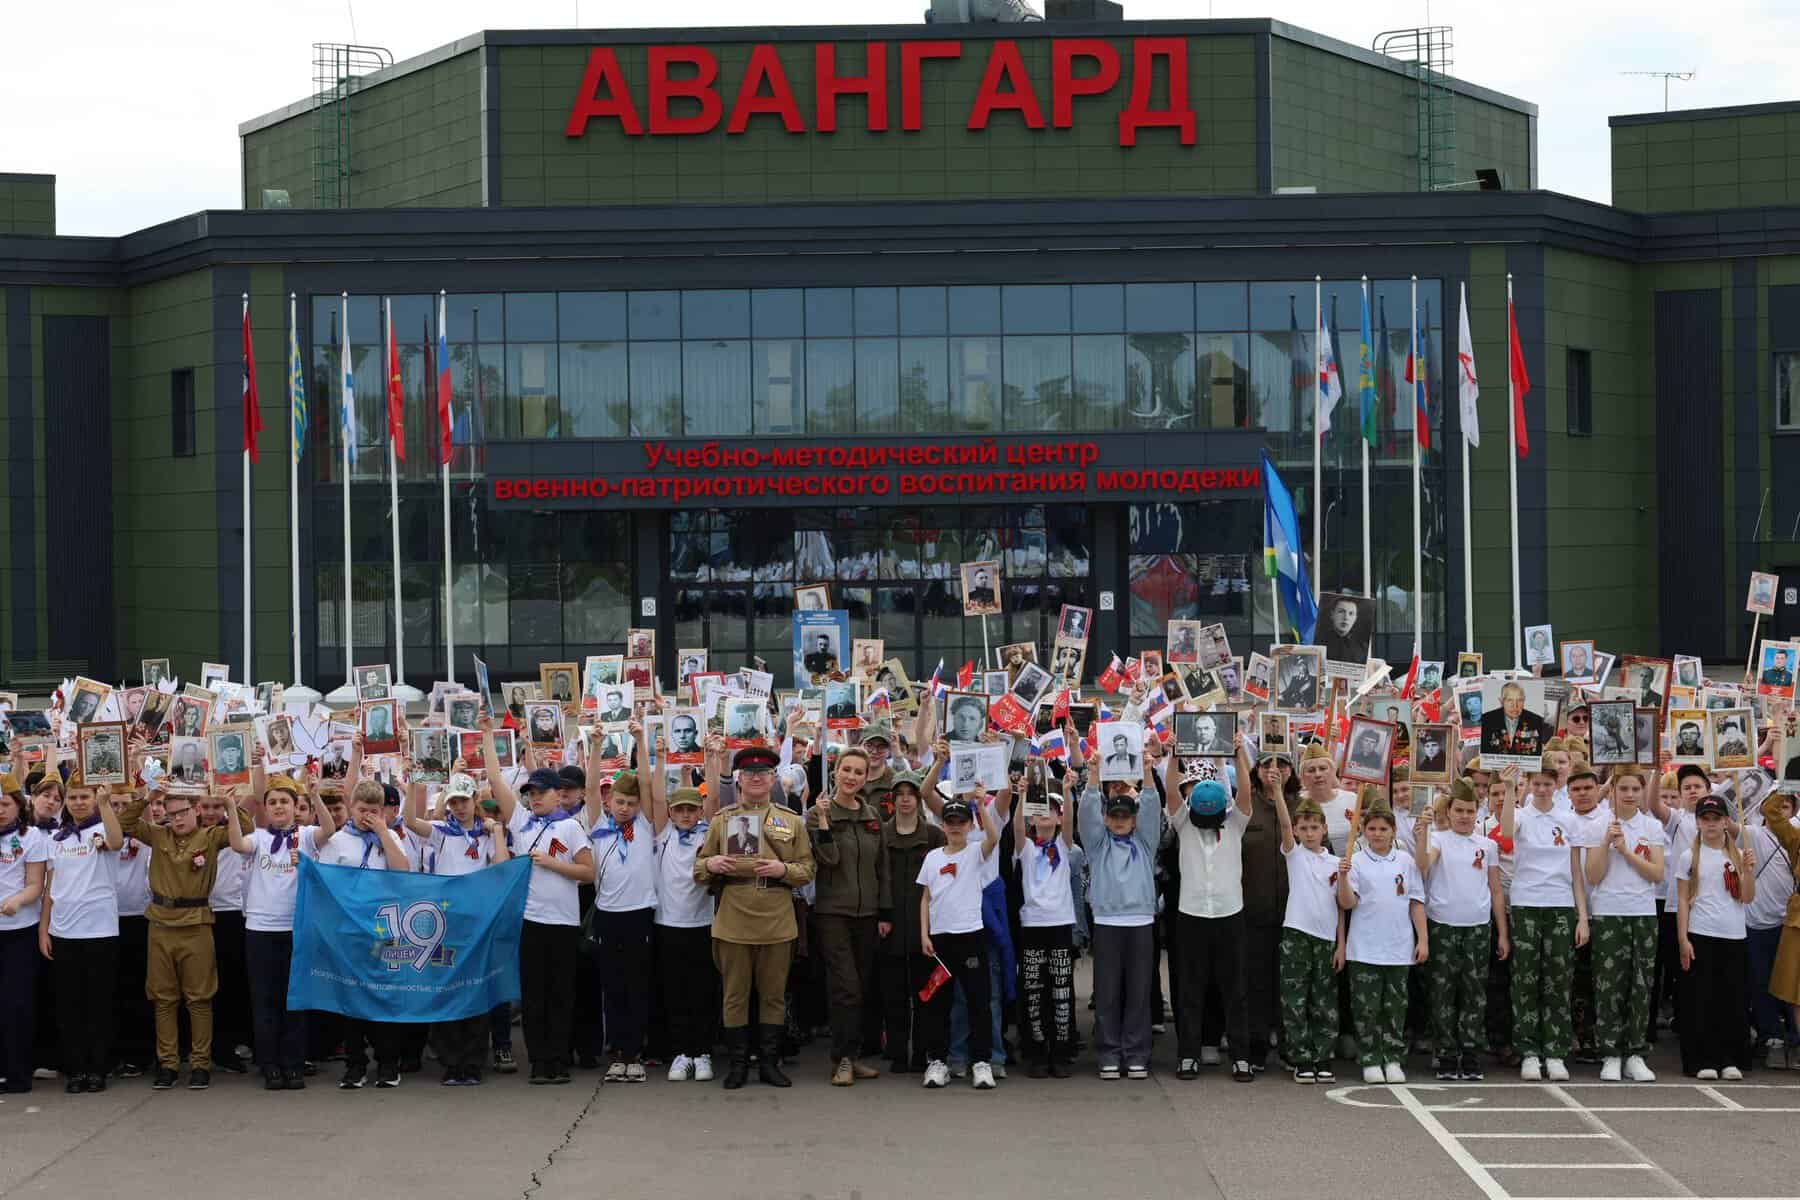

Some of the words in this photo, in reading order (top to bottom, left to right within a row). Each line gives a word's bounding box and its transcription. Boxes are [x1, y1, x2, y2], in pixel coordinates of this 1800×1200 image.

[565, 37, 1197, 146] АВАНГАРД
[644, 439, 997, 469] Учебно-методический
[1006, 443, 1099, 468] центр
[494, 473, 889, 502] военно-патриотического
[899, 472, 1087, 494] воспитания
[1096, 467, 1261, 492] молодежи
[375, 900, 447, 973] 19
